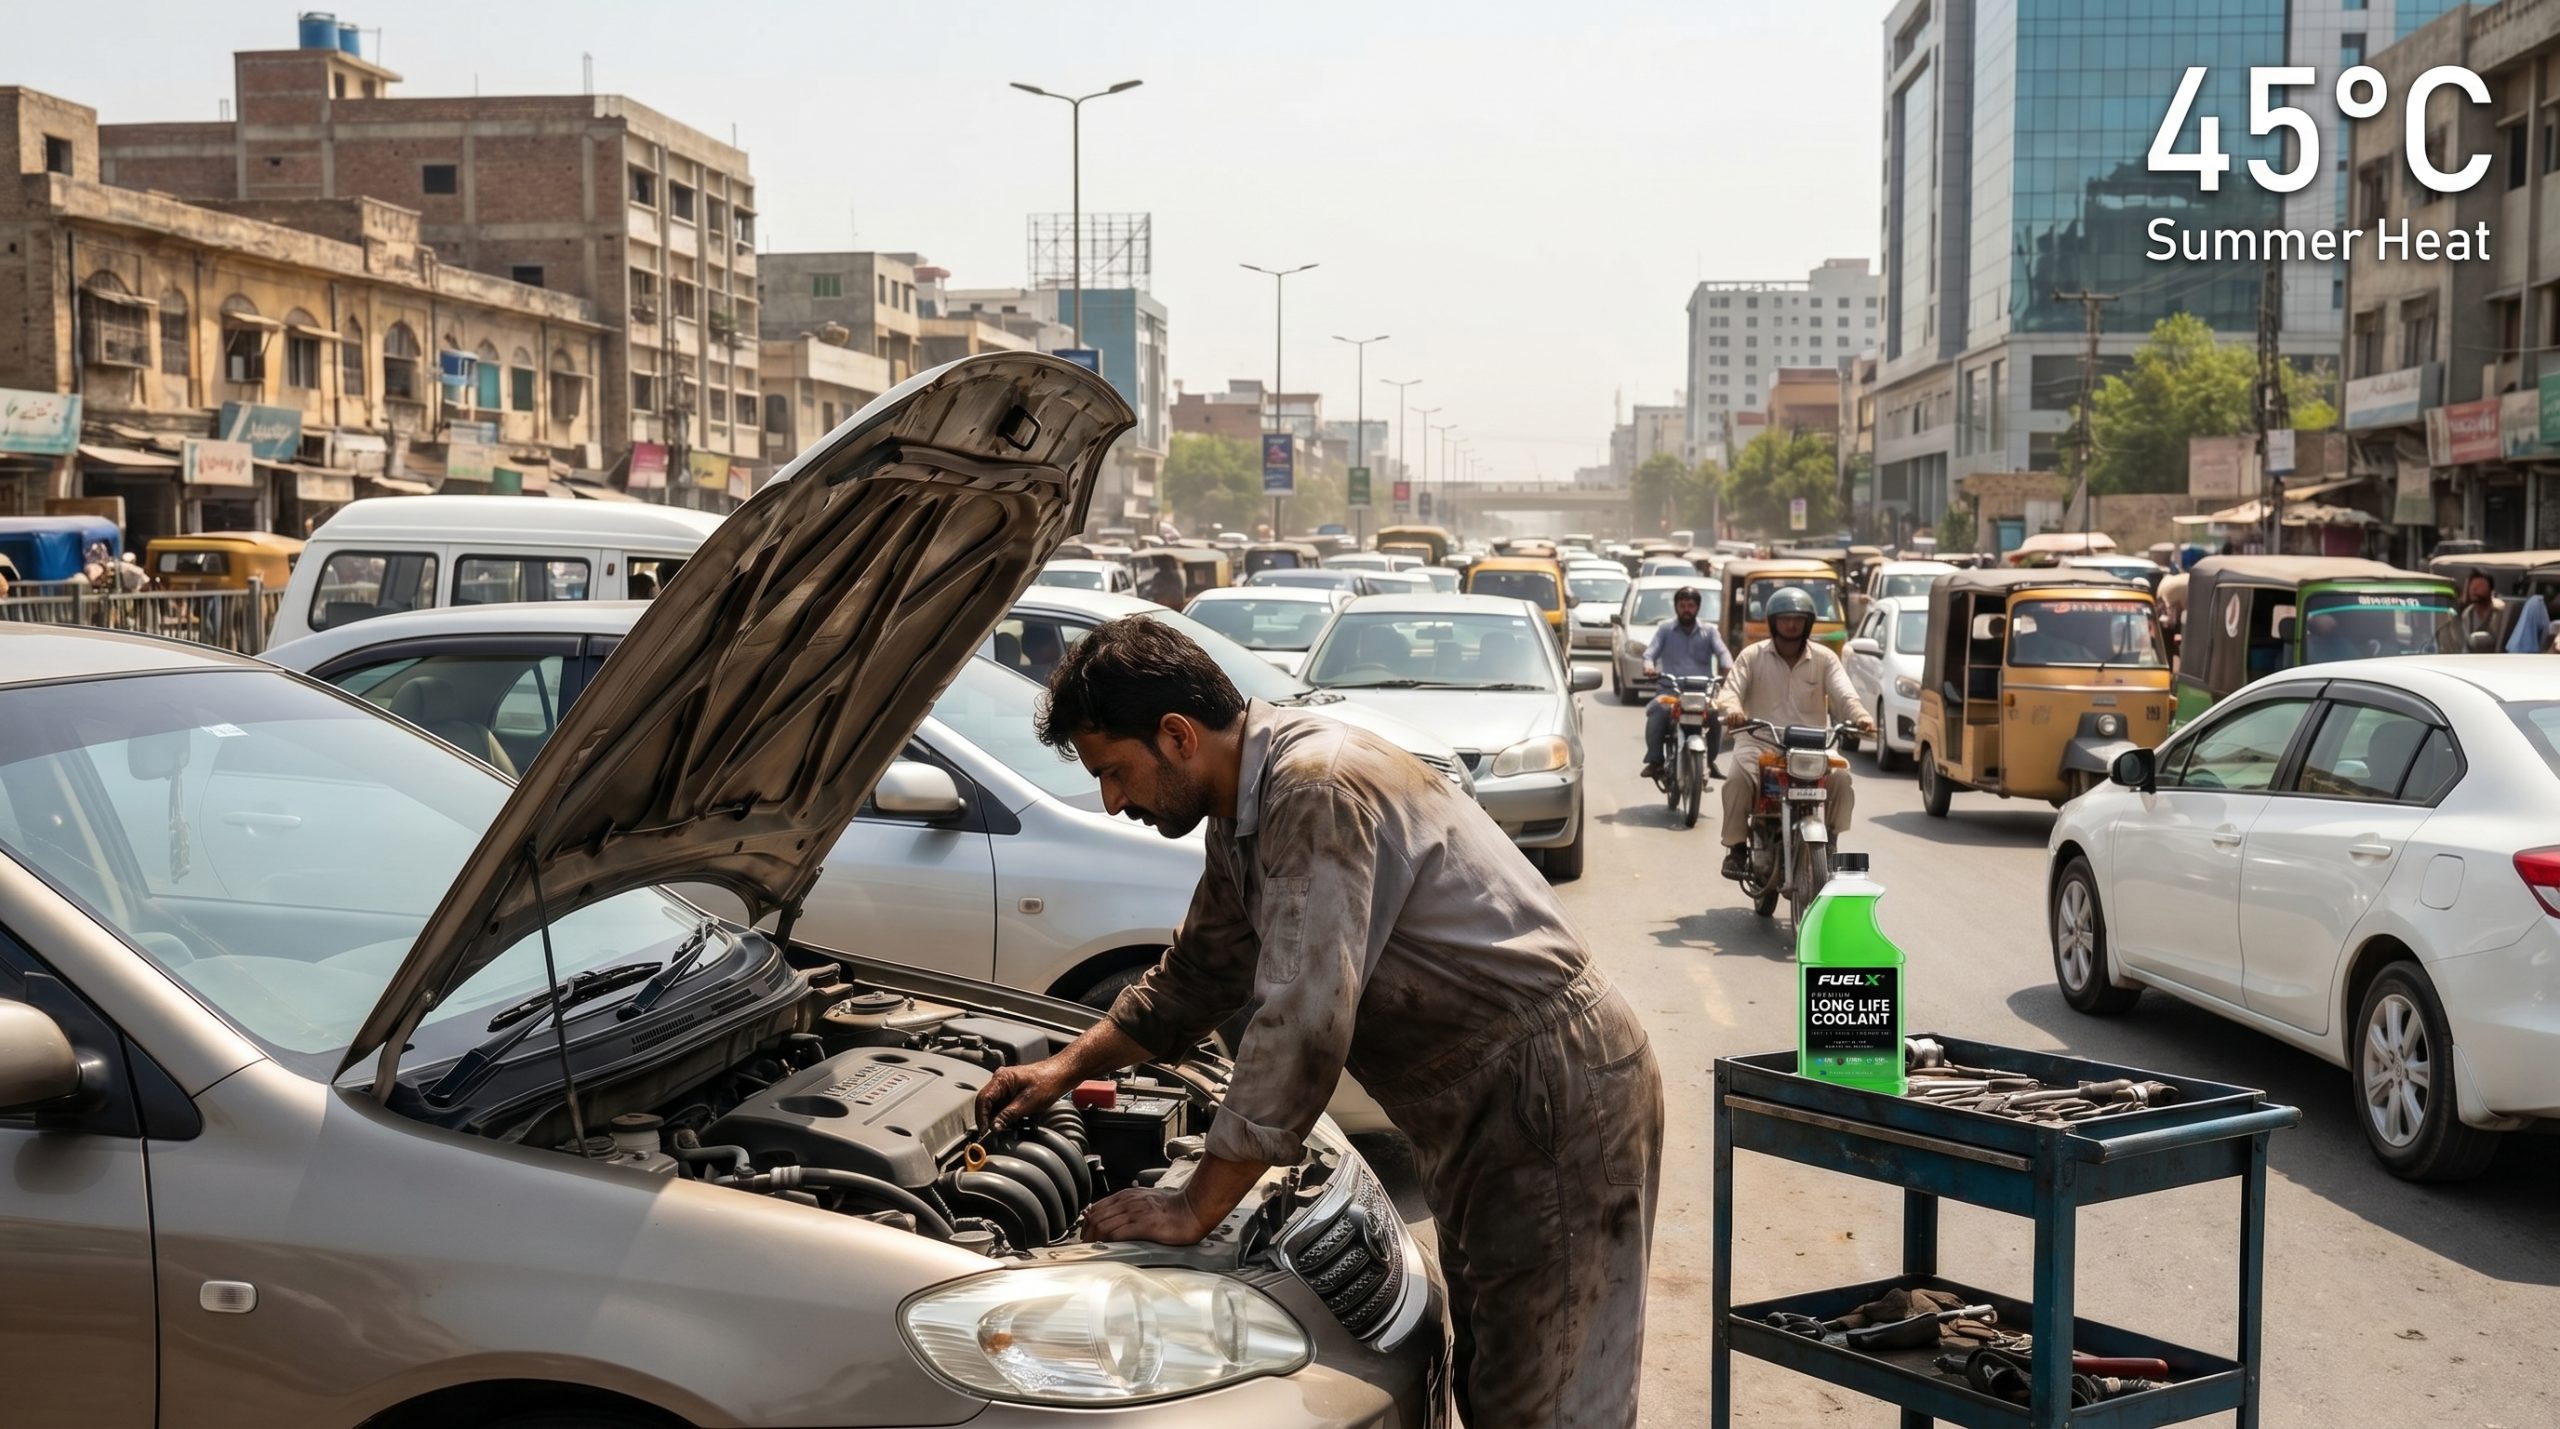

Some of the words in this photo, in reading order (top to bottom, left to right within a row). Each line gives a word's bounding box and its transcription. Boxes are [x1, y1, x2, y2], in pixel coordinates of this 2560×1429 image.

[1811, 999, 1855, 1012] LONG
[1859, 999, 1890, 1012] LIFE
[1811, 1013, 1890, 1025] COOLANT
